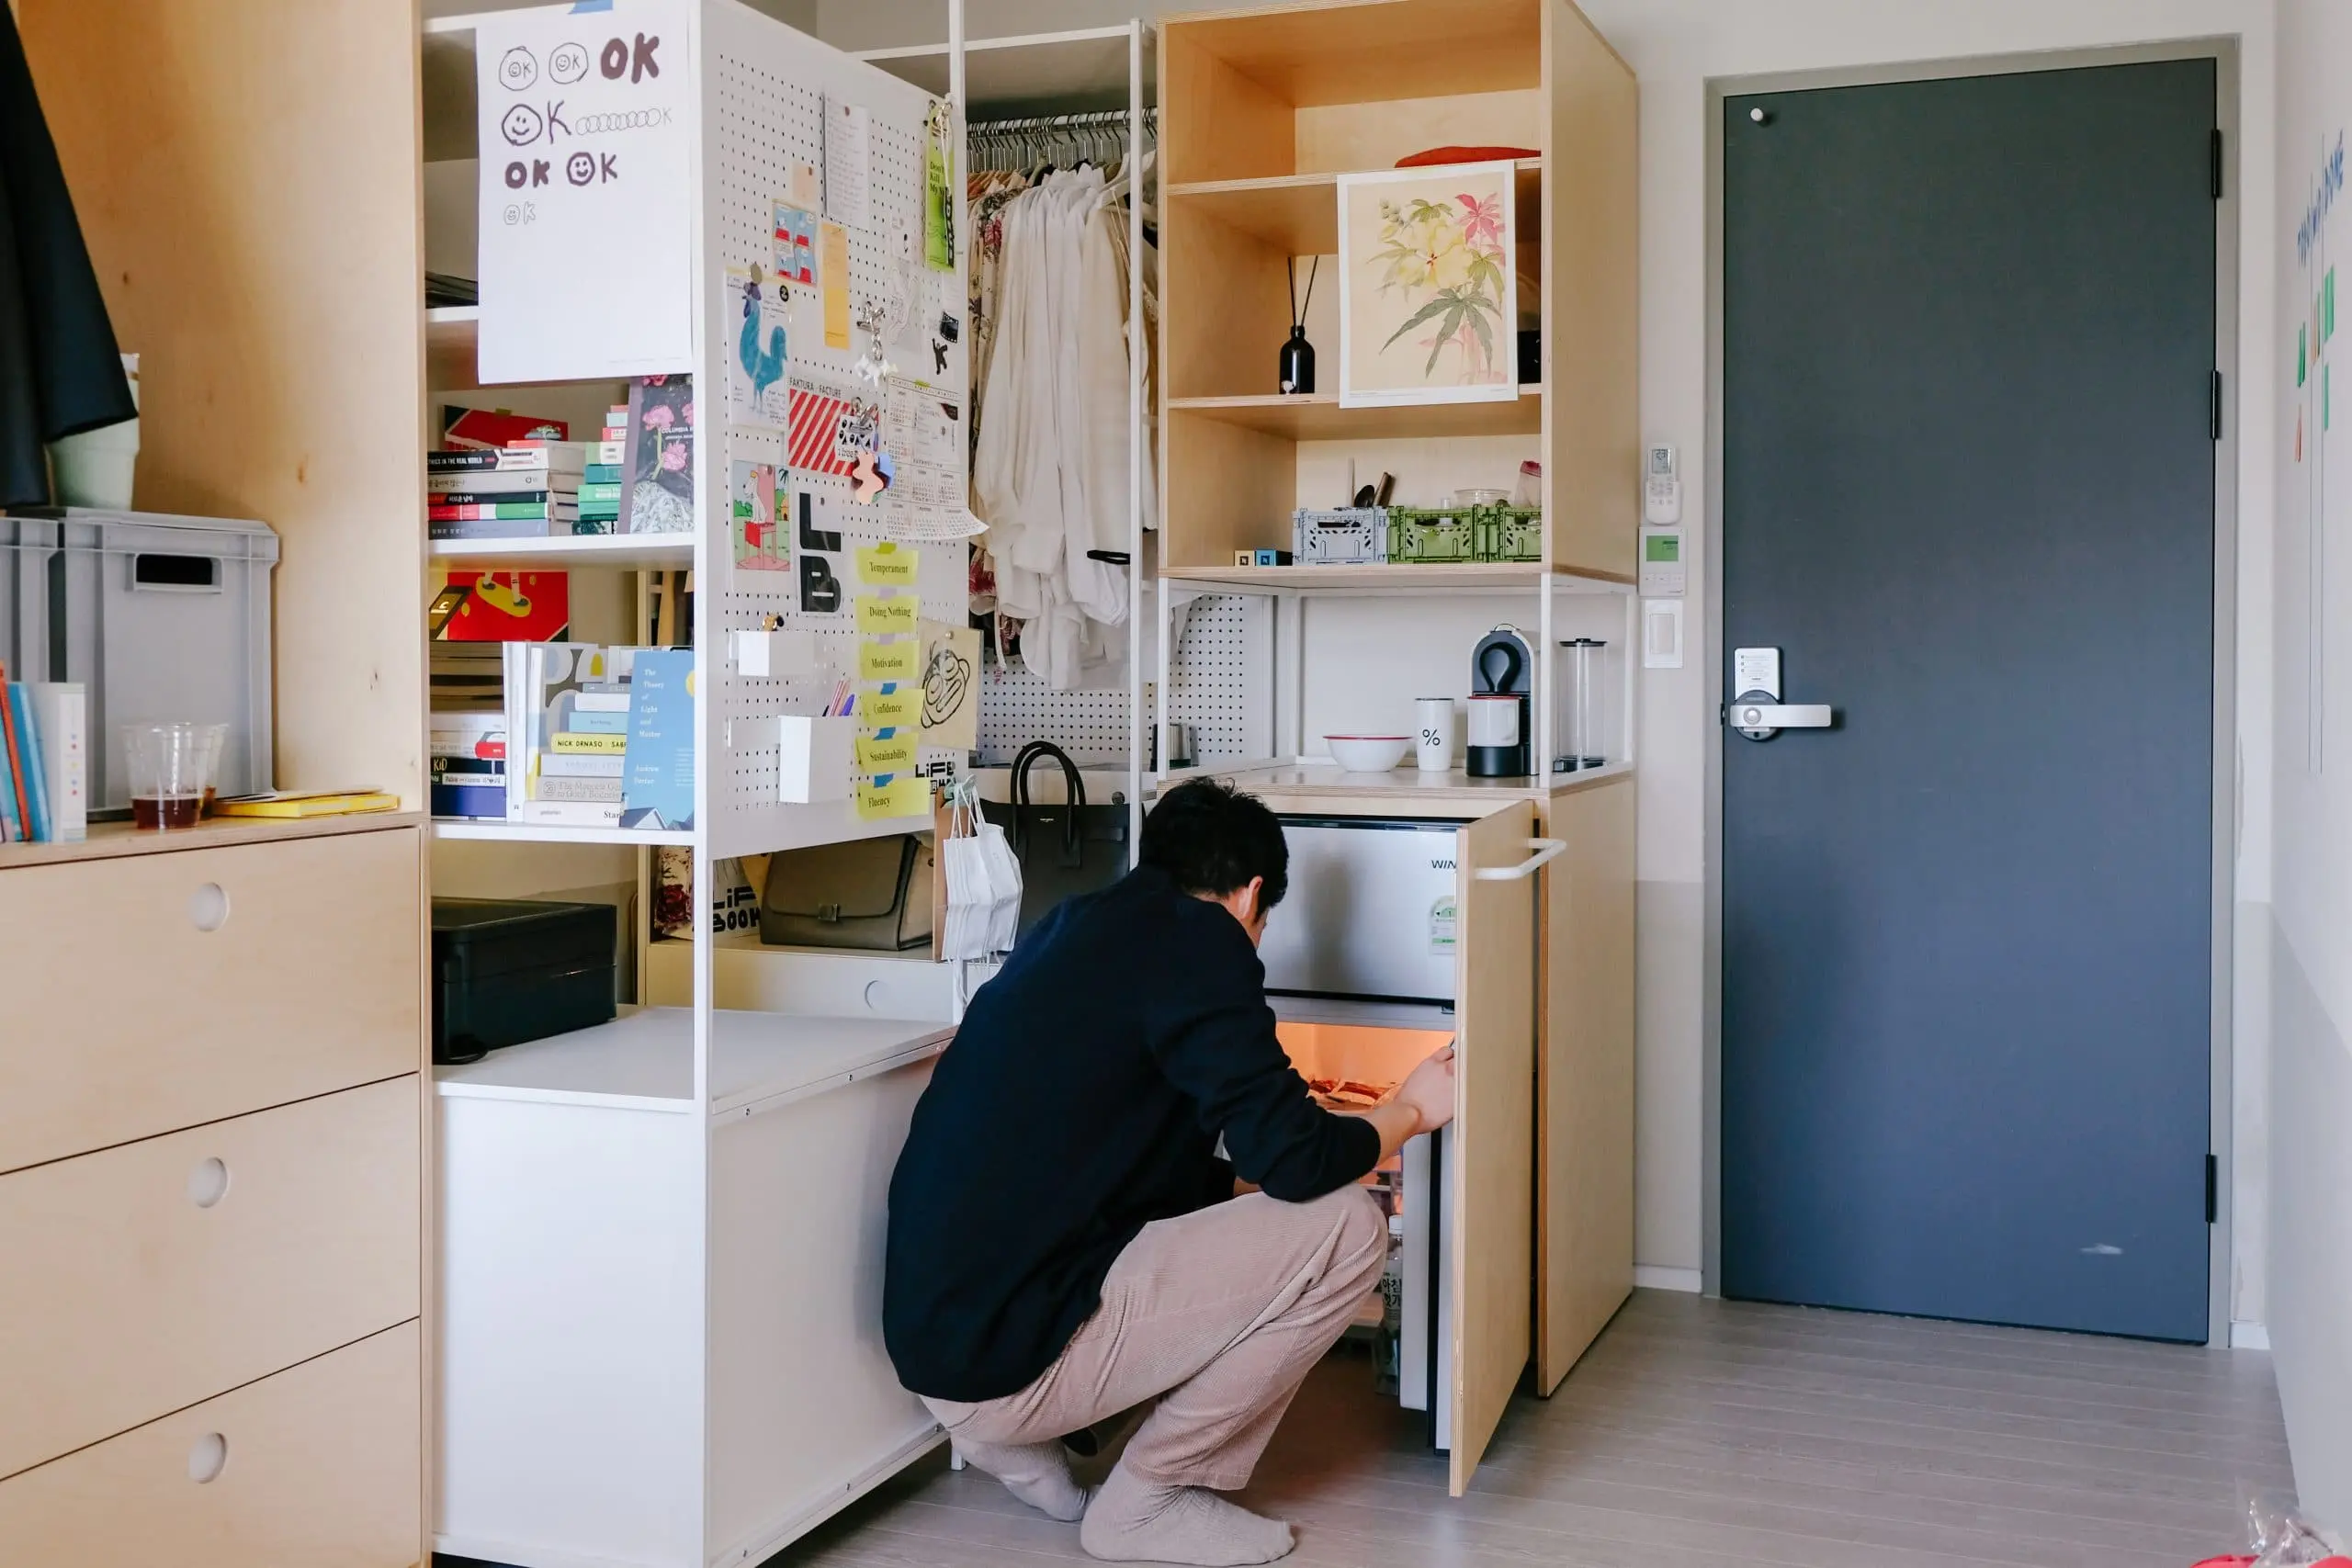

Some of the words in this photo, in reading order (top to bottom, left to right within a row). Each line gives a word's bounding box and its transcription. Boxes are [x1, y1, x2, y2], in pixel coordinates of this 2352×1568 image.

[601, 32, 660, 85] OK
[505, 159, 550, 189] OK
[789, 377, 814, 390] FAKTURA
[868, 561, 909, 576] Temperament
[869, 606, 888, 618] Doing
[888, 606, 911, 618] Nothing
[871, 658, 903, 669] Motivation
[874, 703, 902, 714] Confidence
[869, 749, 908, 761] Sustainability
[868, 796, 891, 809] Fluency
